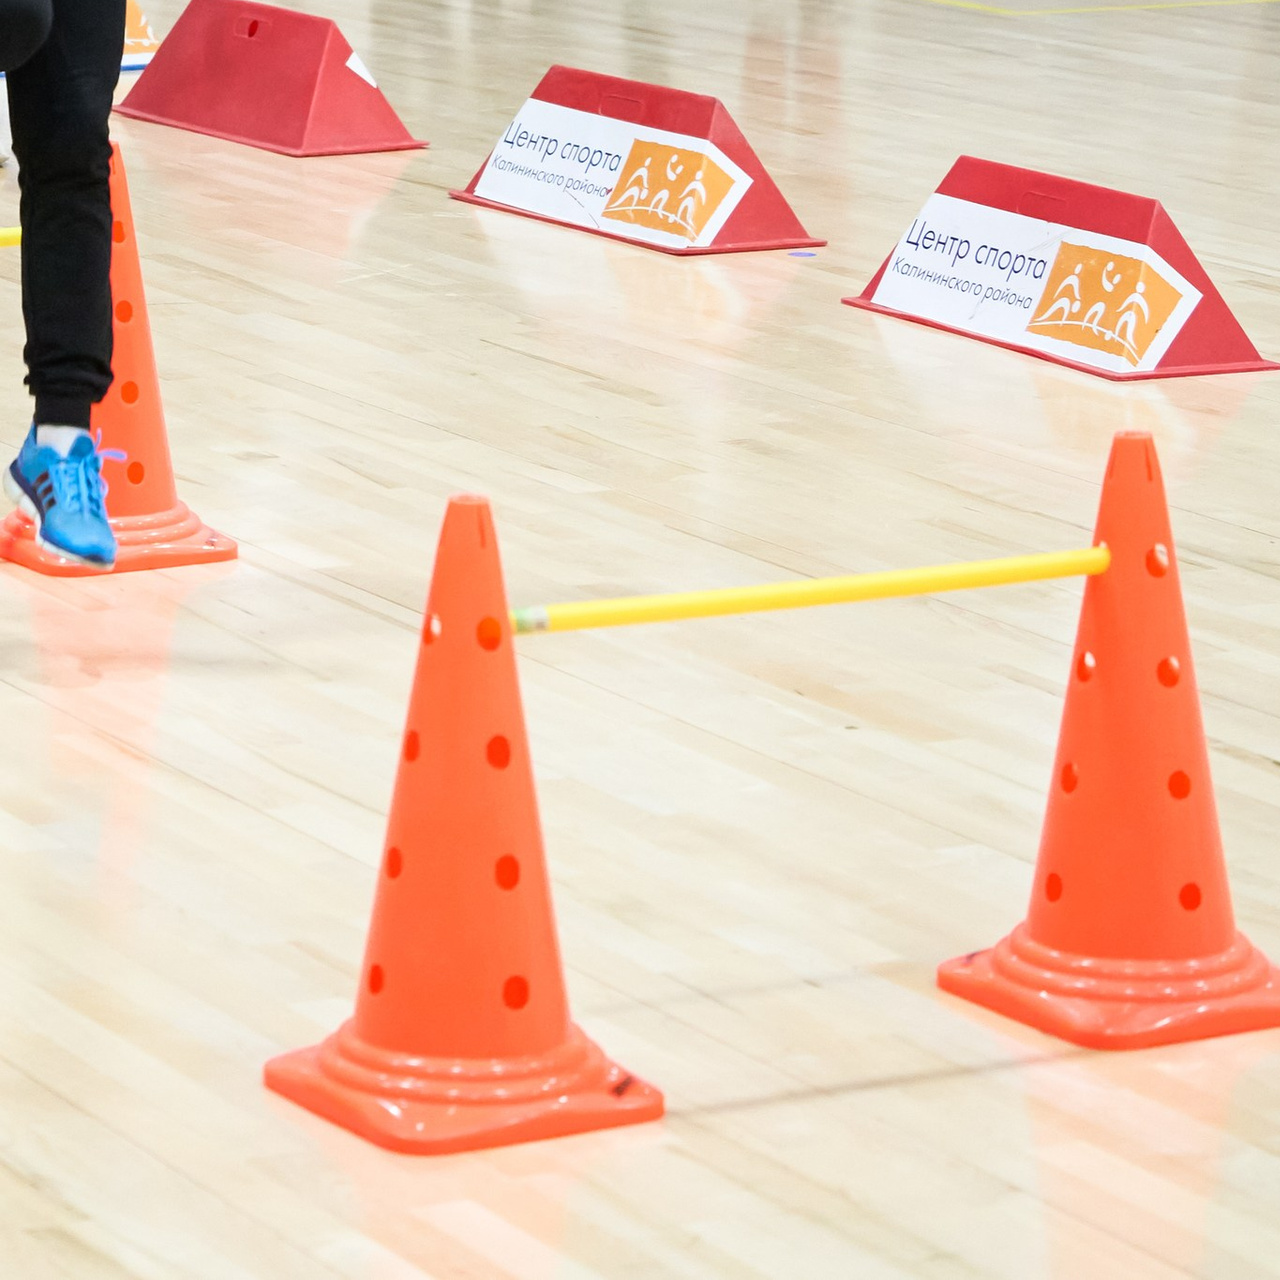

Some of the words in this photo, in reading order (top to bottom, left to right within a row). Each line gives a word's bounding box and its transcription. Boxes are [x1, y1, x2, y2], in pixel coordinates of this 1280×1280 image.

[504, 121, 558, 164] Центр
[561, 141, 621, 175] спорта
[491, 154, 565, 186] Калининского
[564, 177, 608, 198] района
[906, 219, 971, 267] Центр
[974, 243, 1048, 283] спорта
[893, 257, 983, 296] Калининского
[980, 283, 1033, 310] района
